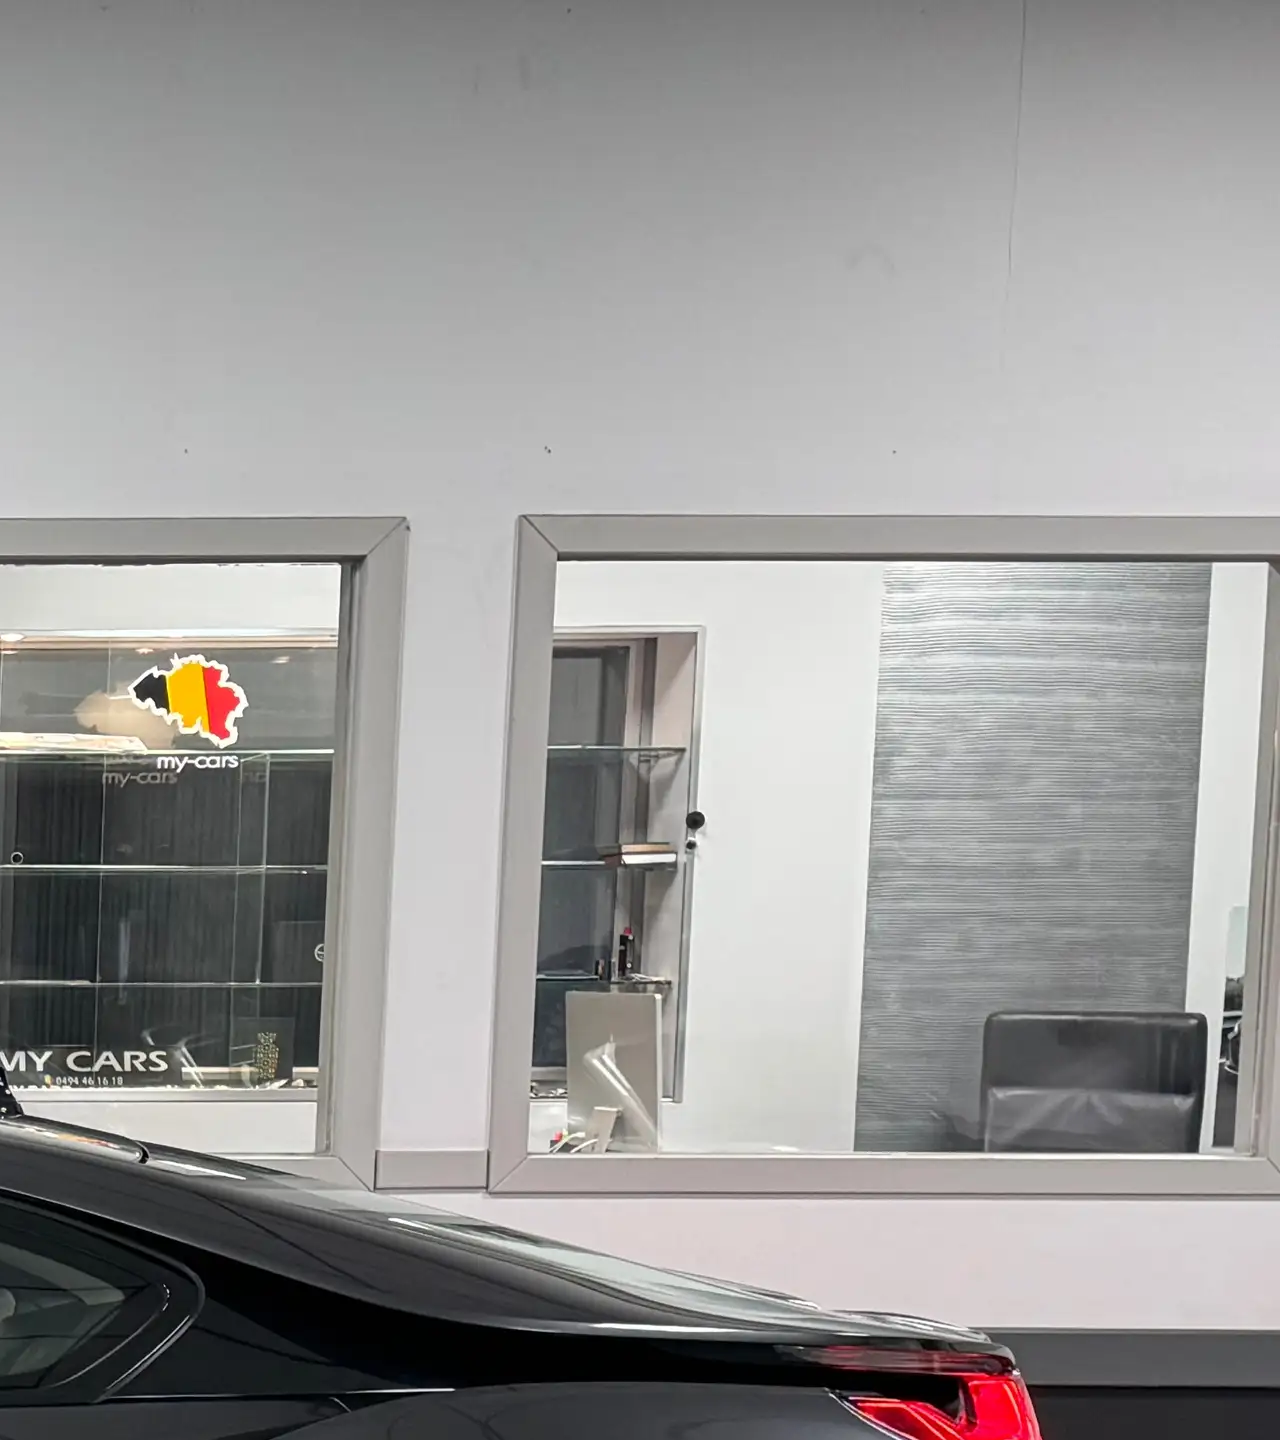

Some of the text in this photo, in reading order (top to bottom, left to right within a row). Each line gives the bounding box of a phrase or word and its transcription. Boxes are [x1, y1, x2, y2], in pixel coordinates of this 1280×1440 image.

[156, 754, 239, 773] my-cars
[65, 1050, 169, 1073] CARS
[82, 1076, 95, 1086] 46
[97, 1076, 109, 1086] 16
